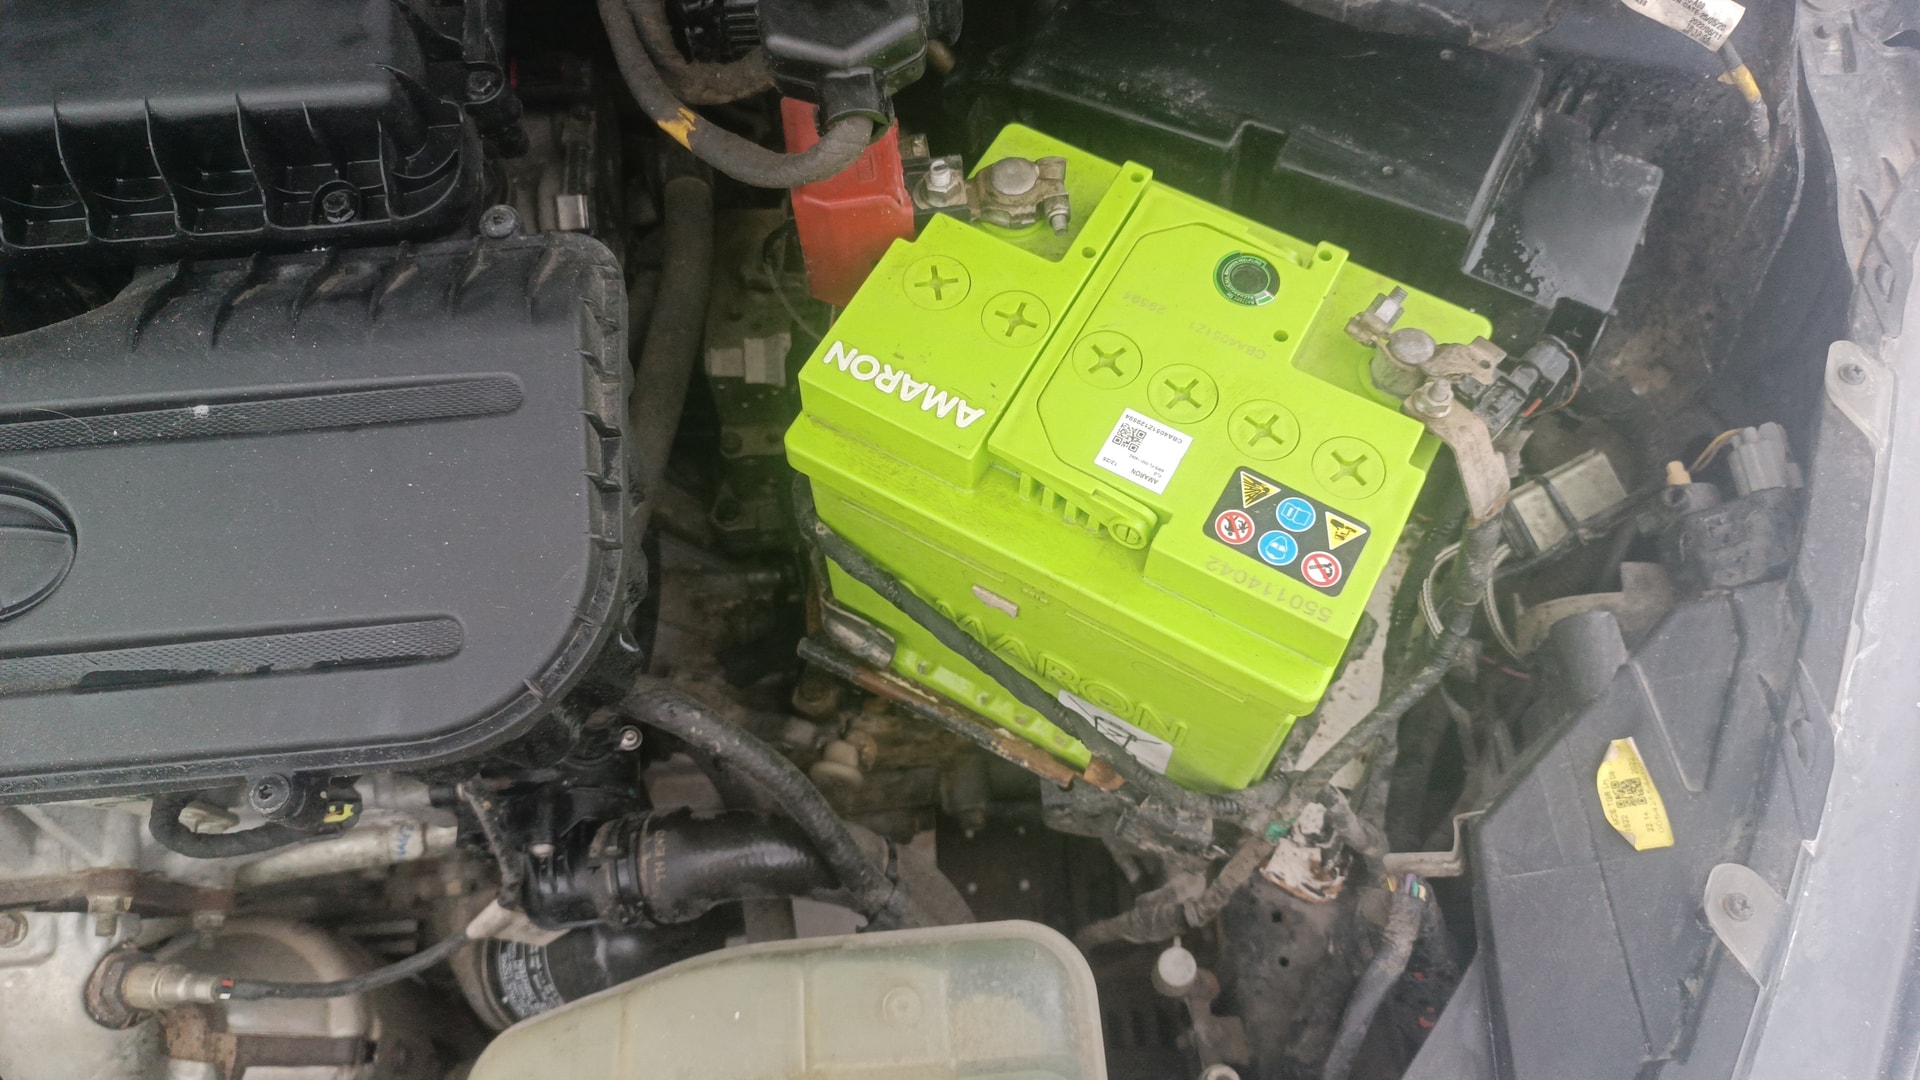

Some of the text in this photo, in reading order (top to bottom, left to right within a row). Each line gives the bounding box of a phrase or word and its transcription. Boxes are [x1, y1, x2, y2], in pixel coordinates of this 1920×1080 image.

[823, 340, 986, 429] AMARON
[1130, 468, 1159, 485] AMARON
[1205, 555, 1333, 624] 550114042
